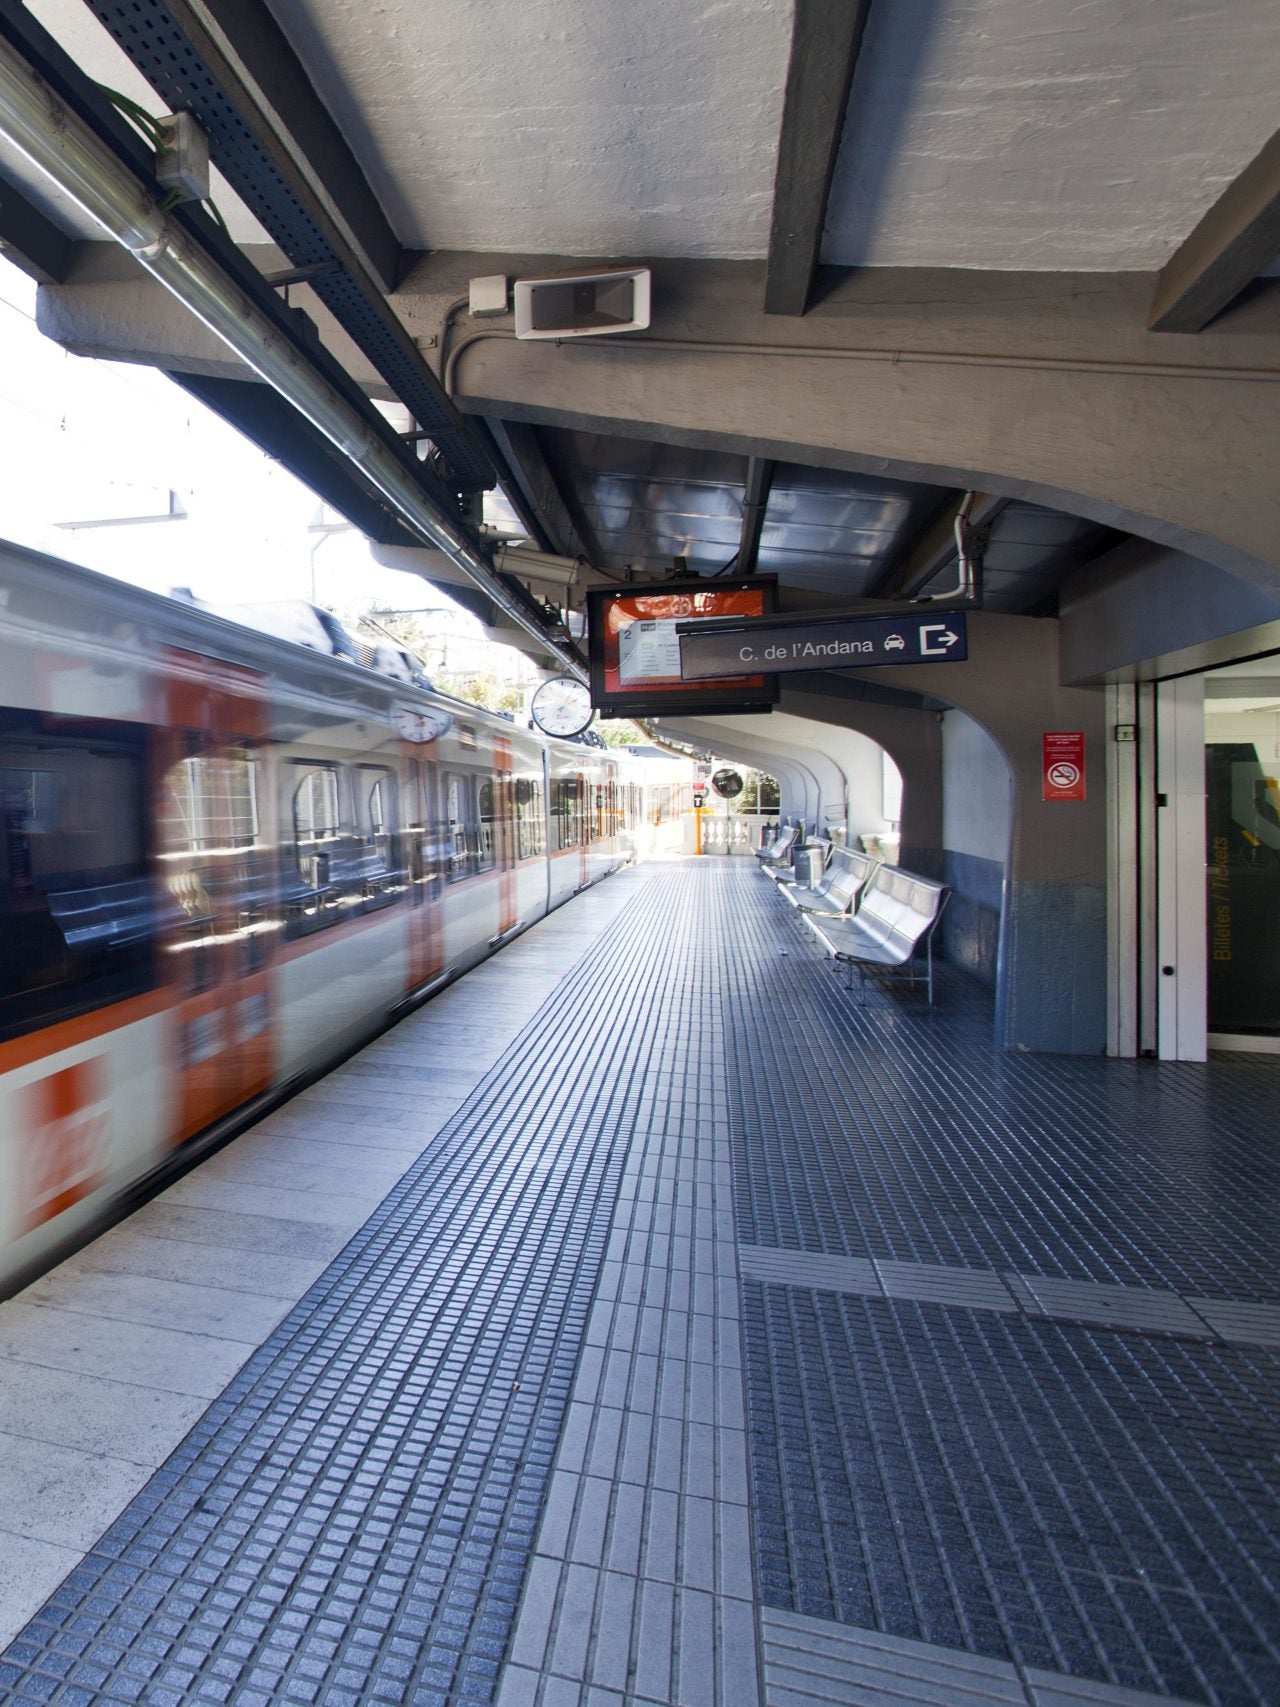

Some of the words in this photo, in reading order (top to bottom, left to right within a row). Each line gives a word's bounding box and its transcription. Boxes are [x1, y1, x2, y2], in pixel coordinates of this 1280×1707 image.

[739, 647, 759, 662] C.
[764, 645, 787, 660] de
[792, 640, 874, 658] l'Andana
[1212, 836, 1230, 889] Tickets
[1214, 905, 1232, 960] Billetes
